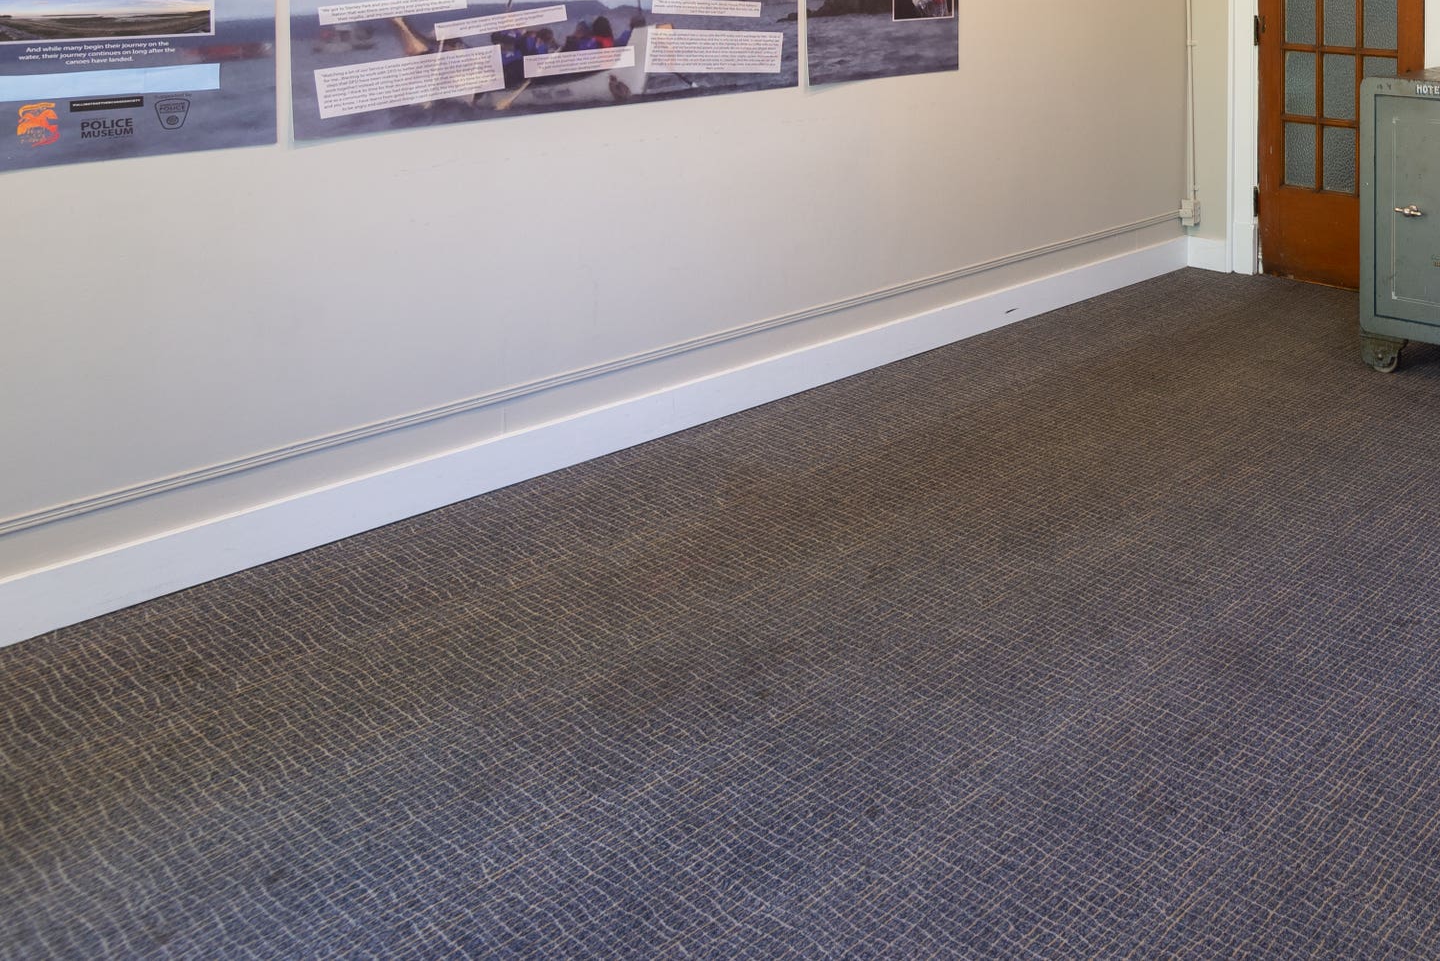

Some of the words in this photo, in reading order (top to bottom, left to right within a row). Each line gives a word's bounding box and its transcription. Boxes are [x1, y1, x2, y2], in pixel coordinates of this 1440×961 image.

[63, 44, 83, 52] many
[84, 43, 104, 51] begin
[121, 41, 147, 49] journey
[60, 51, 87, 60] journey
[88, 49, 122, 57] continues
[132, 48, 148, 56] long
[91, 56, 108, 64] have
[81, 118, 133, 131] POLICE
[81, 127, 133, 139] MUSEUM
